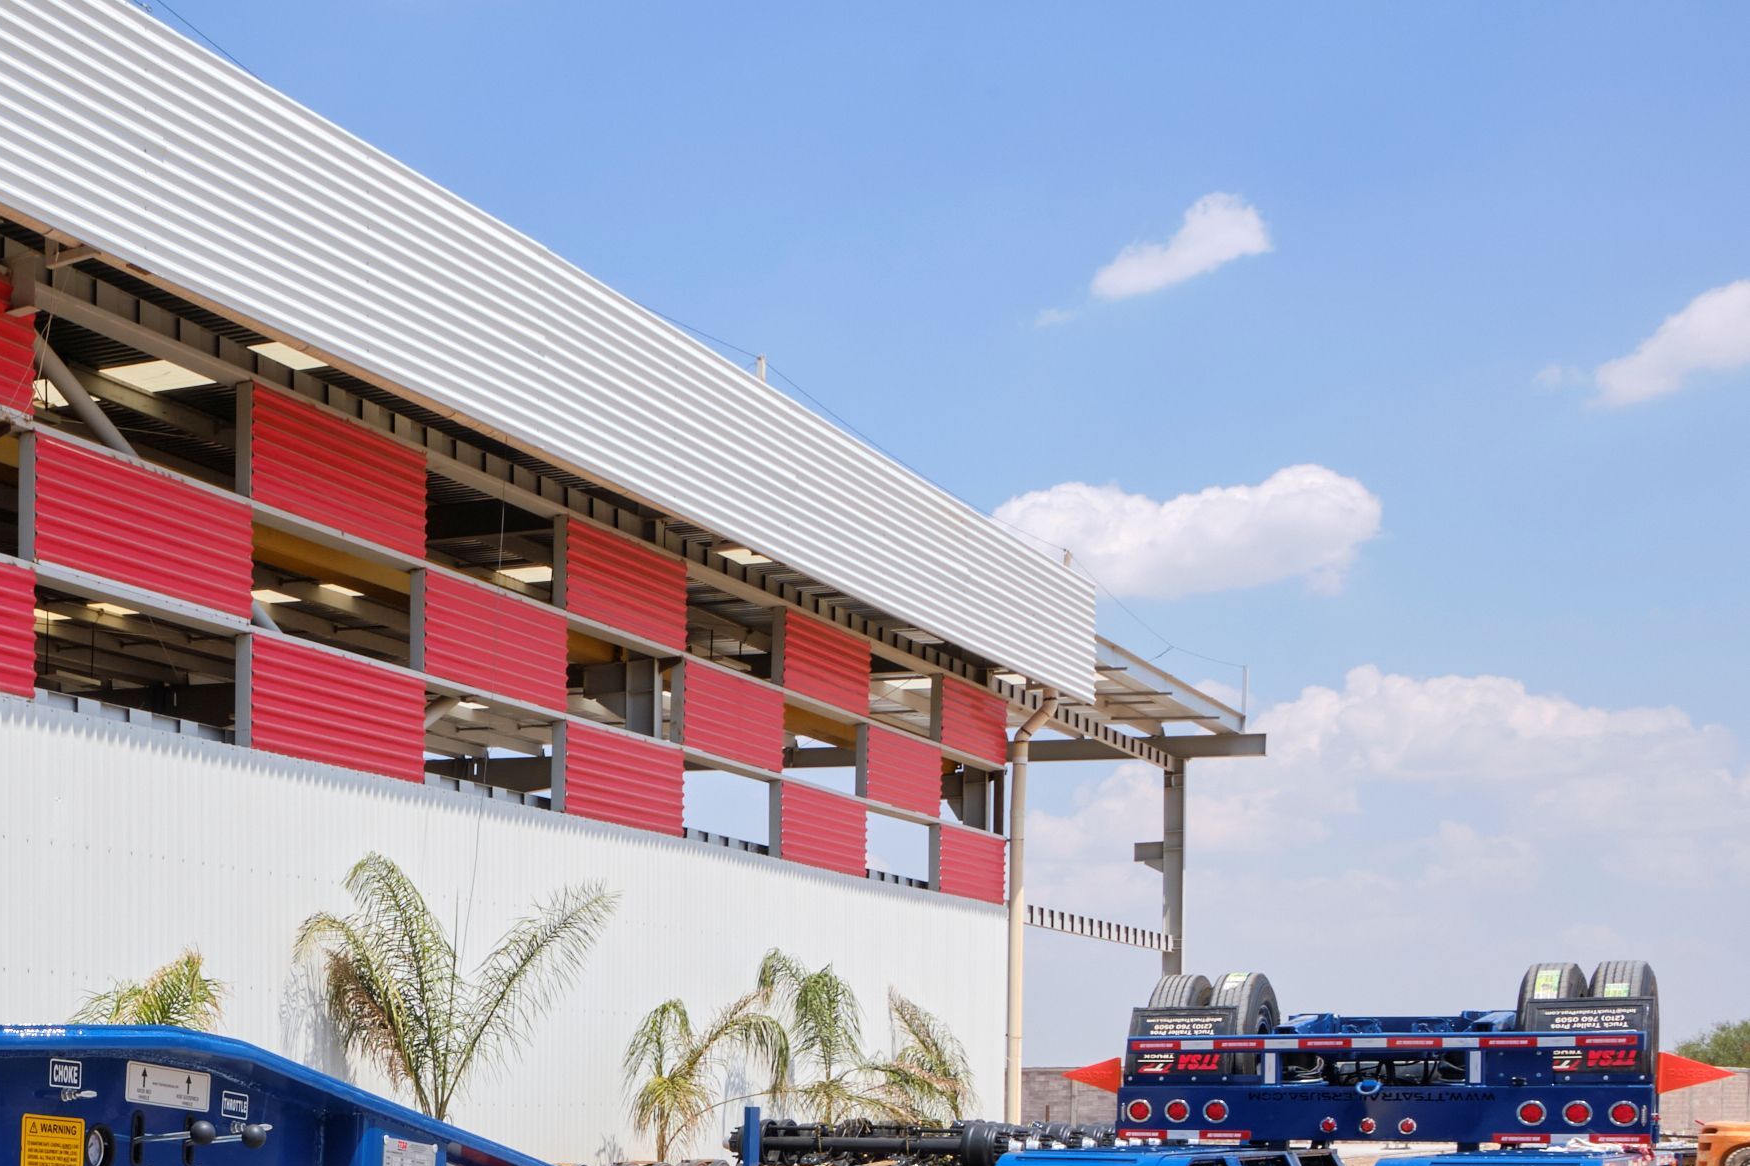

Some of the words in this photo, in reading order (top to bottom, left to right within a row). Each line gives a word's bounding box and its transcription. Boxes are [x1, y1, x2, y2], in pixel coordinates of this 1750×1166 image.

[1545, 1004, 1636, 1015] info@TruckTrailerPros.com
[1178, 1054, 1220, 1070] TTSA
[1587, 1050, 1637, 1067] TTSA
[54, 1064, 78, 1084] CHOKE
[224, 1098, 248, 1114] THROTTLE
[40, 1122, 78, 1136] WARNING
